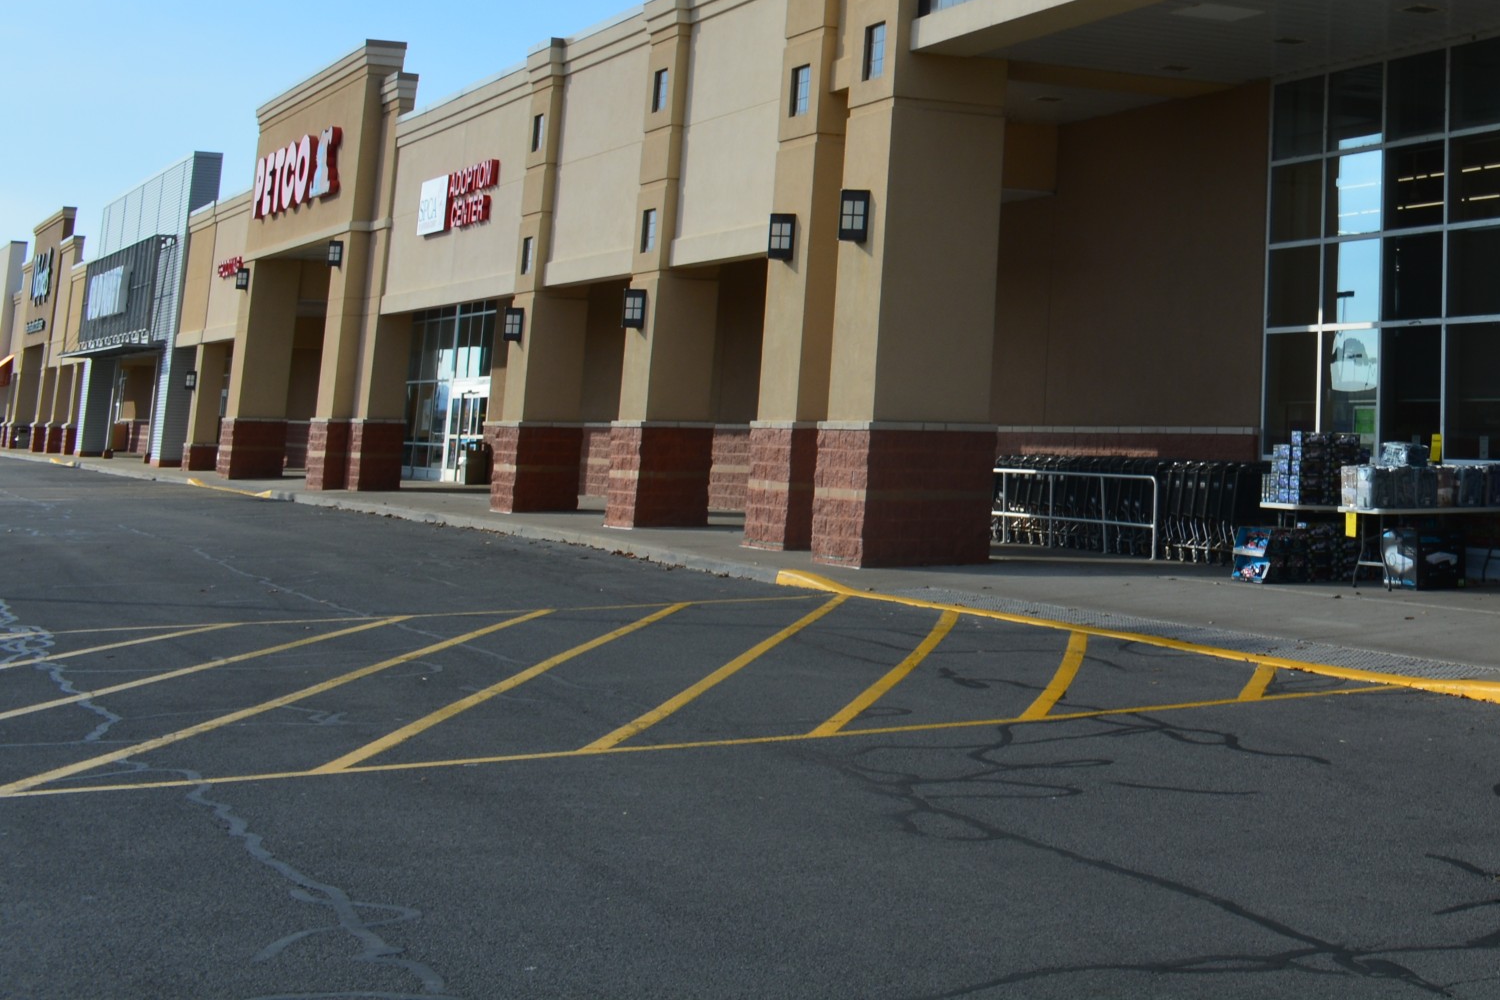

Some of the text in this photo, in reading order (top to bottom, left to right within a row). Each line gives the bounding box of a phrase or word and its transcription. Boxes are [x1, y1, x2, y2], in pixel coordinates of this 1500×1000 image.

[252, 133, 313, 219] PETCO
[449, 160, 495, 196] ADOPTION
[450, 195, 486, 227] CENTER
